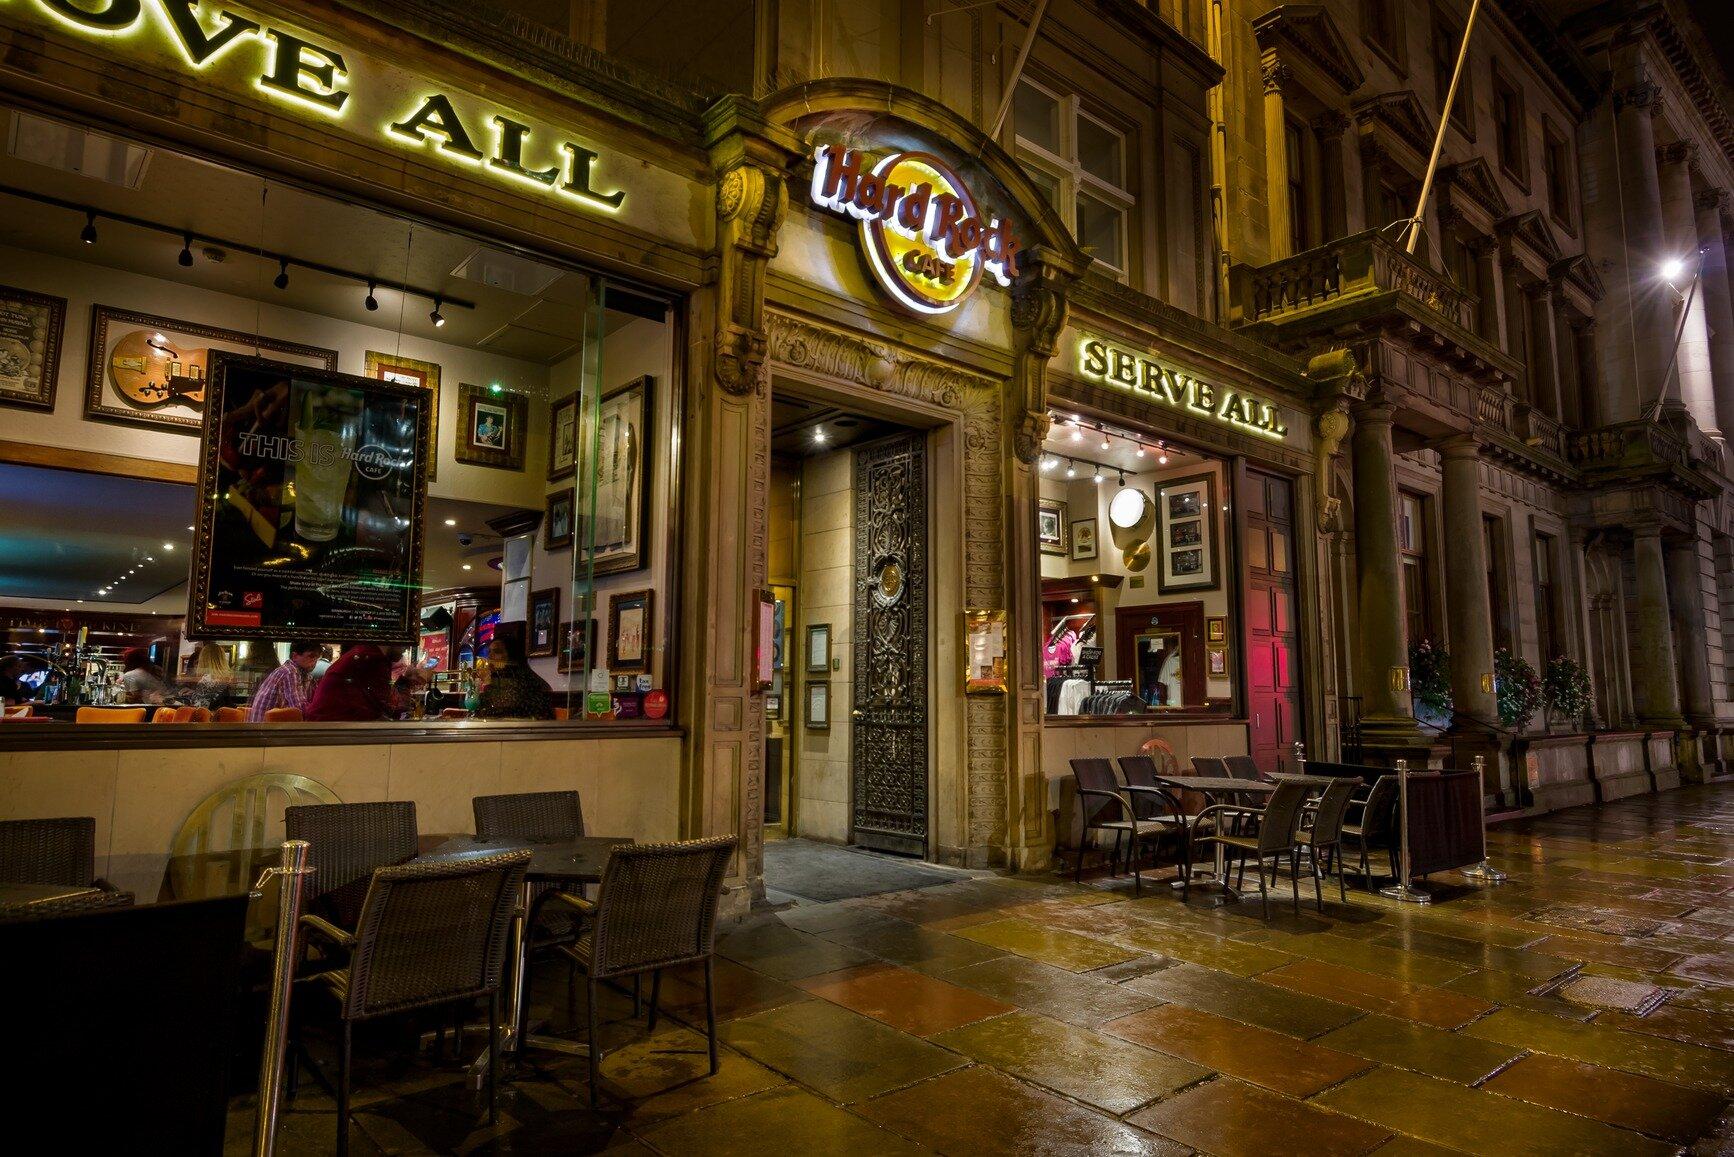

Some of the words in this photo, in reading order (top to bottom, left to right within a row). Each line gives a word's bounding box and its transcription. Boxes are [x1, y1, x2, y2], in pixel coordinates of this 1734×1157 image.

[388, 93, 628, 210] ALL
[813, 144, 933, 237] Hard
[926, 193, 1023, 282] Rock
[902, 249, 956, 286] CAFE
[1081, 339, 1217, 415] SERVE
[1219, 393, 1288, 439] ALL
[239, 432, 305, 462] THIS
[310, 442, 336, 467] IS
[340, 446, 375, 463] Hard
[365, 466, 382, 475] CAFE
